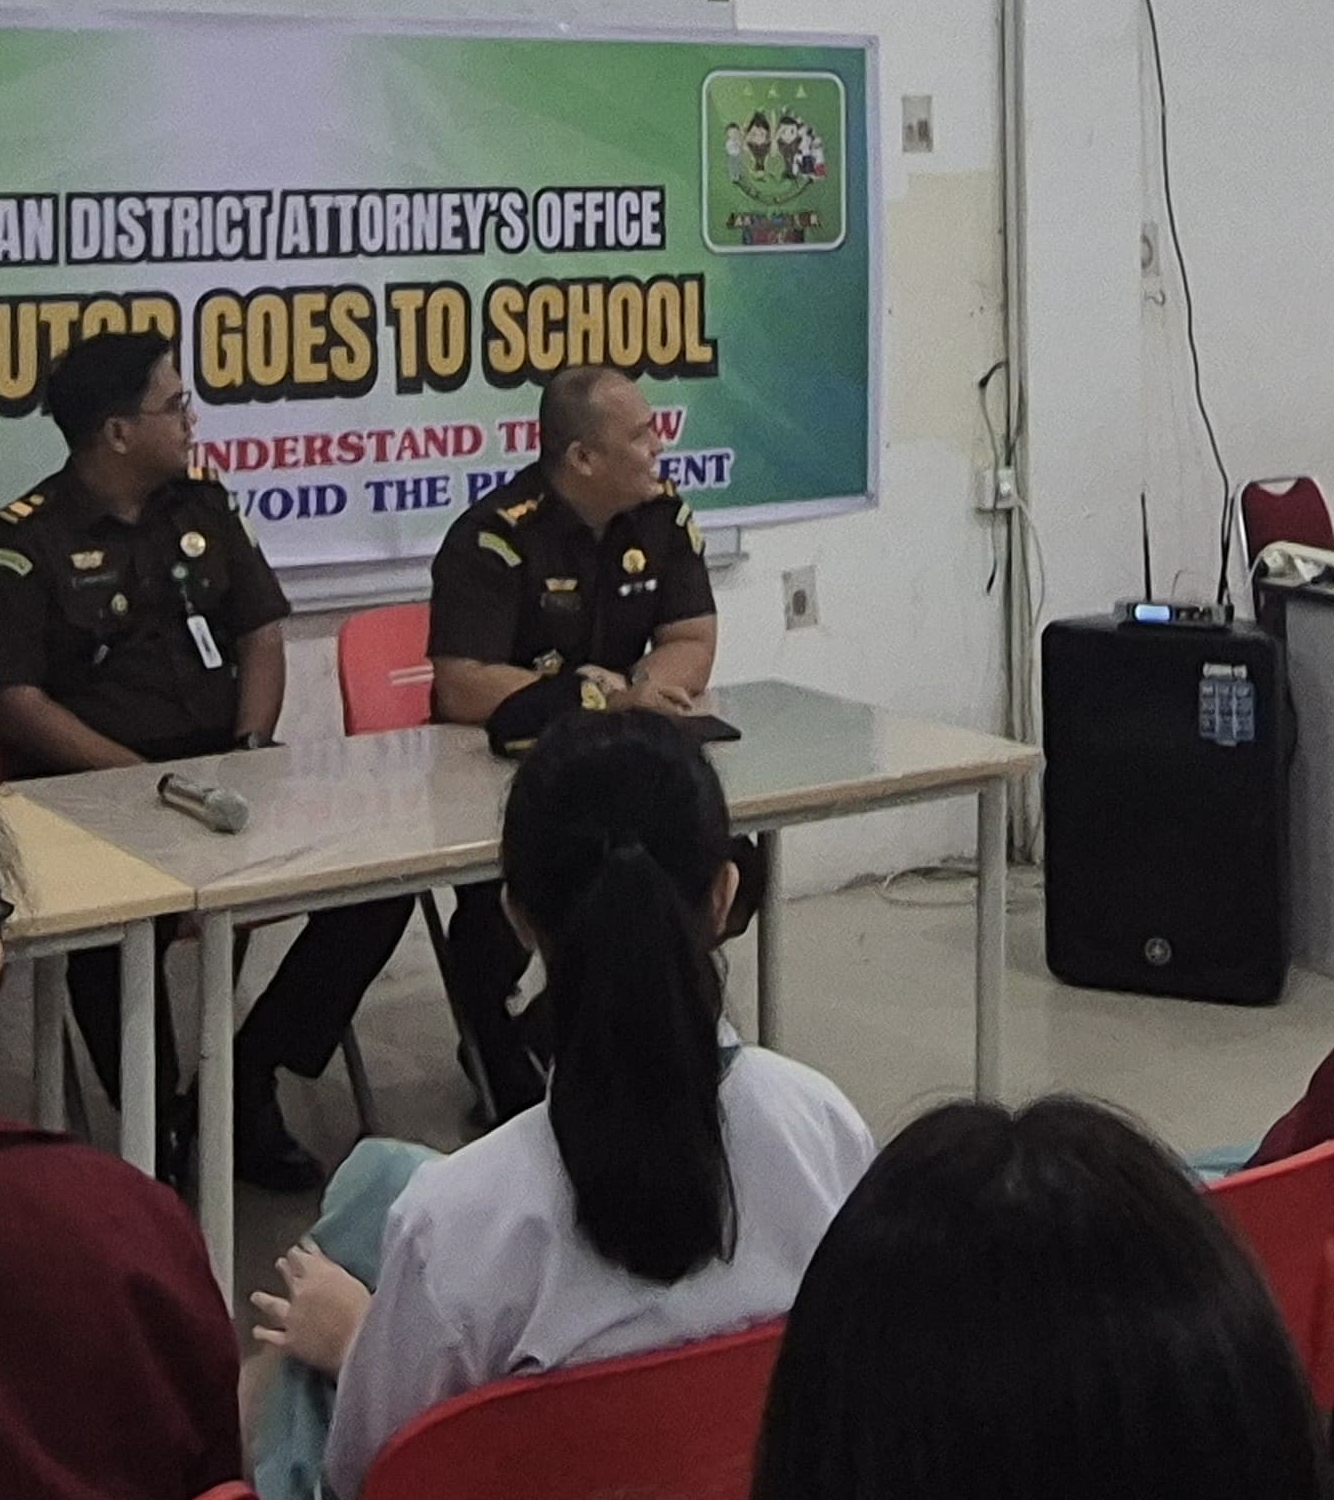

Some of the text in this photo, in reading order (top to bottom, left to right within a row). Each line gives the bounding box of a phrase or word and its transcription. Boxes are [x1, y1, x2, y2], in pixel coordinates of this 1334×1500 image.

[68, 194, 269, 262] DISTRICT
[280, 189, 527, 256] ATTORNEY'S
[535, 188, 663, 249] OFFICE
[199, 290, 372, 388] GOES
[391, 284, 468, 381] TO
[487, 279, 715, 375] SCHOOL
[193, 423, 483, 473] NDERSTAND
[364, 475, 452, 513] THE
